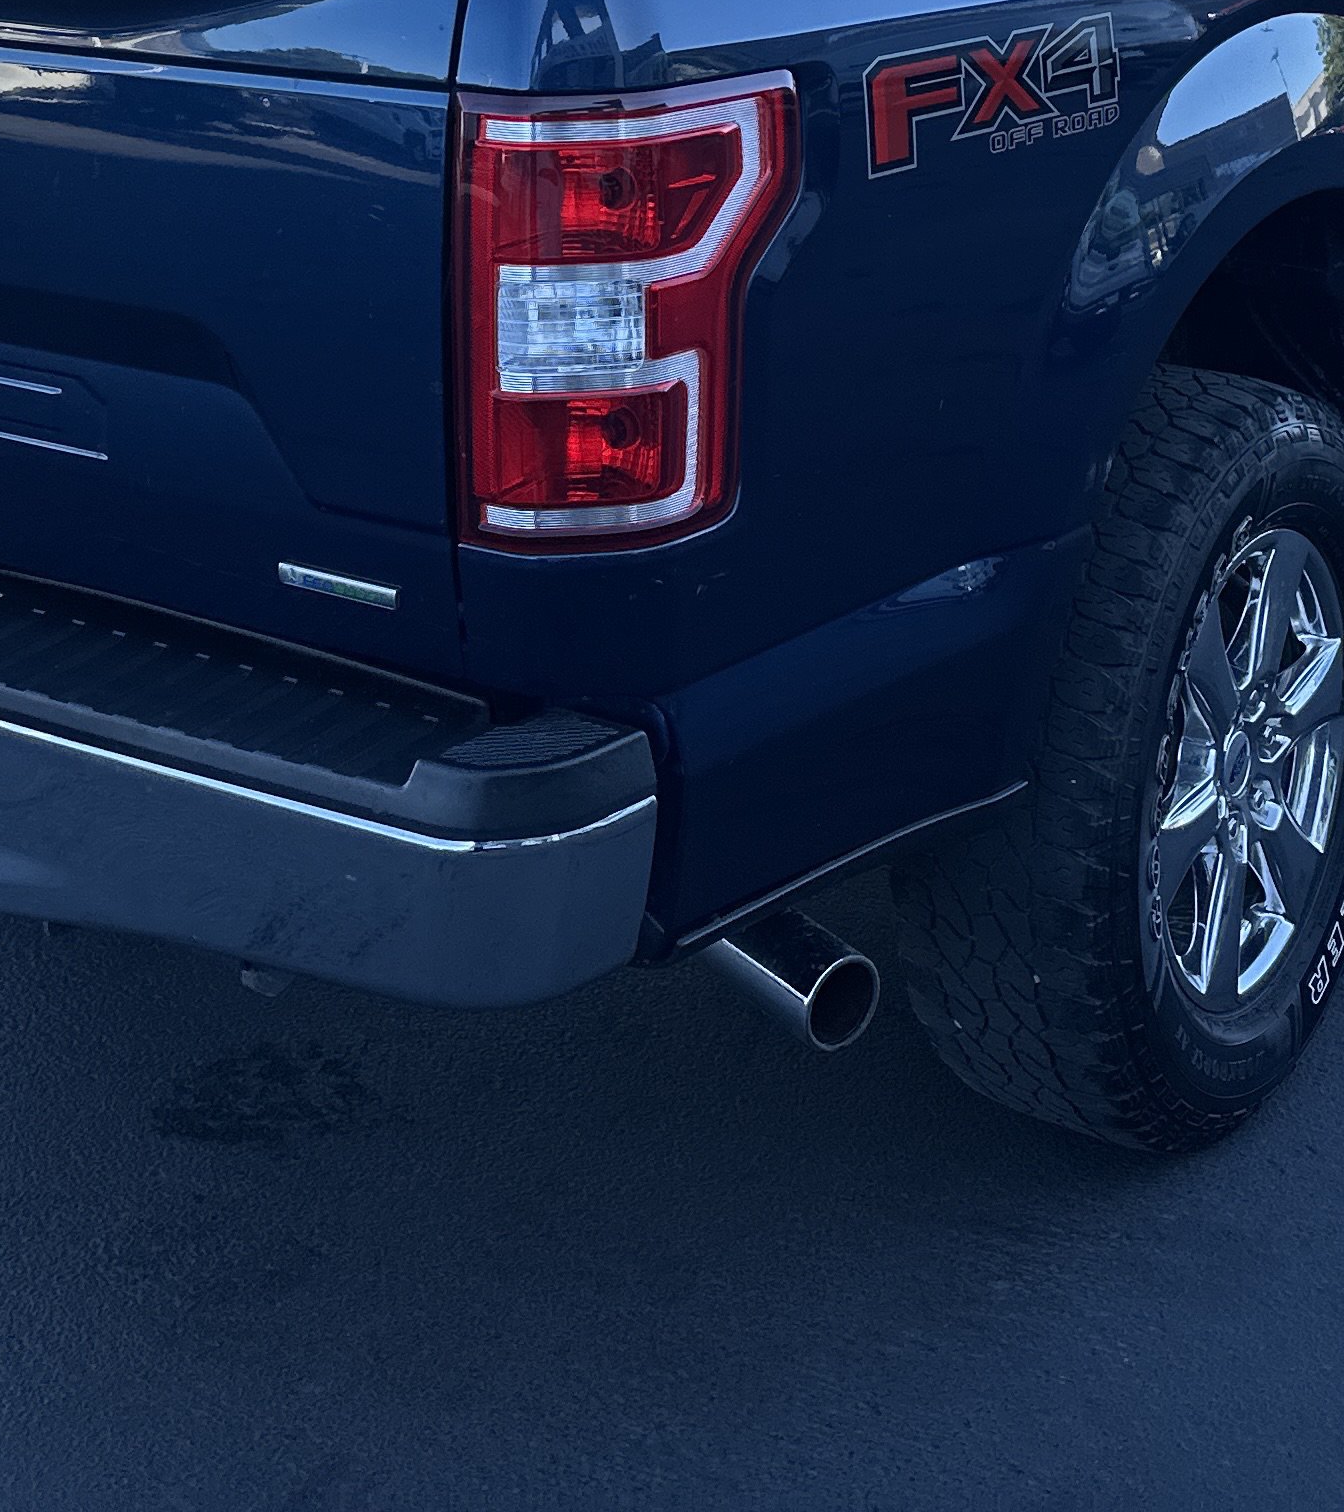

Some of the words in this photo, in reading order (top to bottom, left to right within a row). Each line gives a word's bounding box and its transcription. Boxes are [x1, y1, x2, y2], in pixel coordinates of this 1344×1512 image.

[861, 11, 1121, 180] FX4
[988, 120, 1045, 155] OFF
[1052, 103, 1121, 140] ROAD
